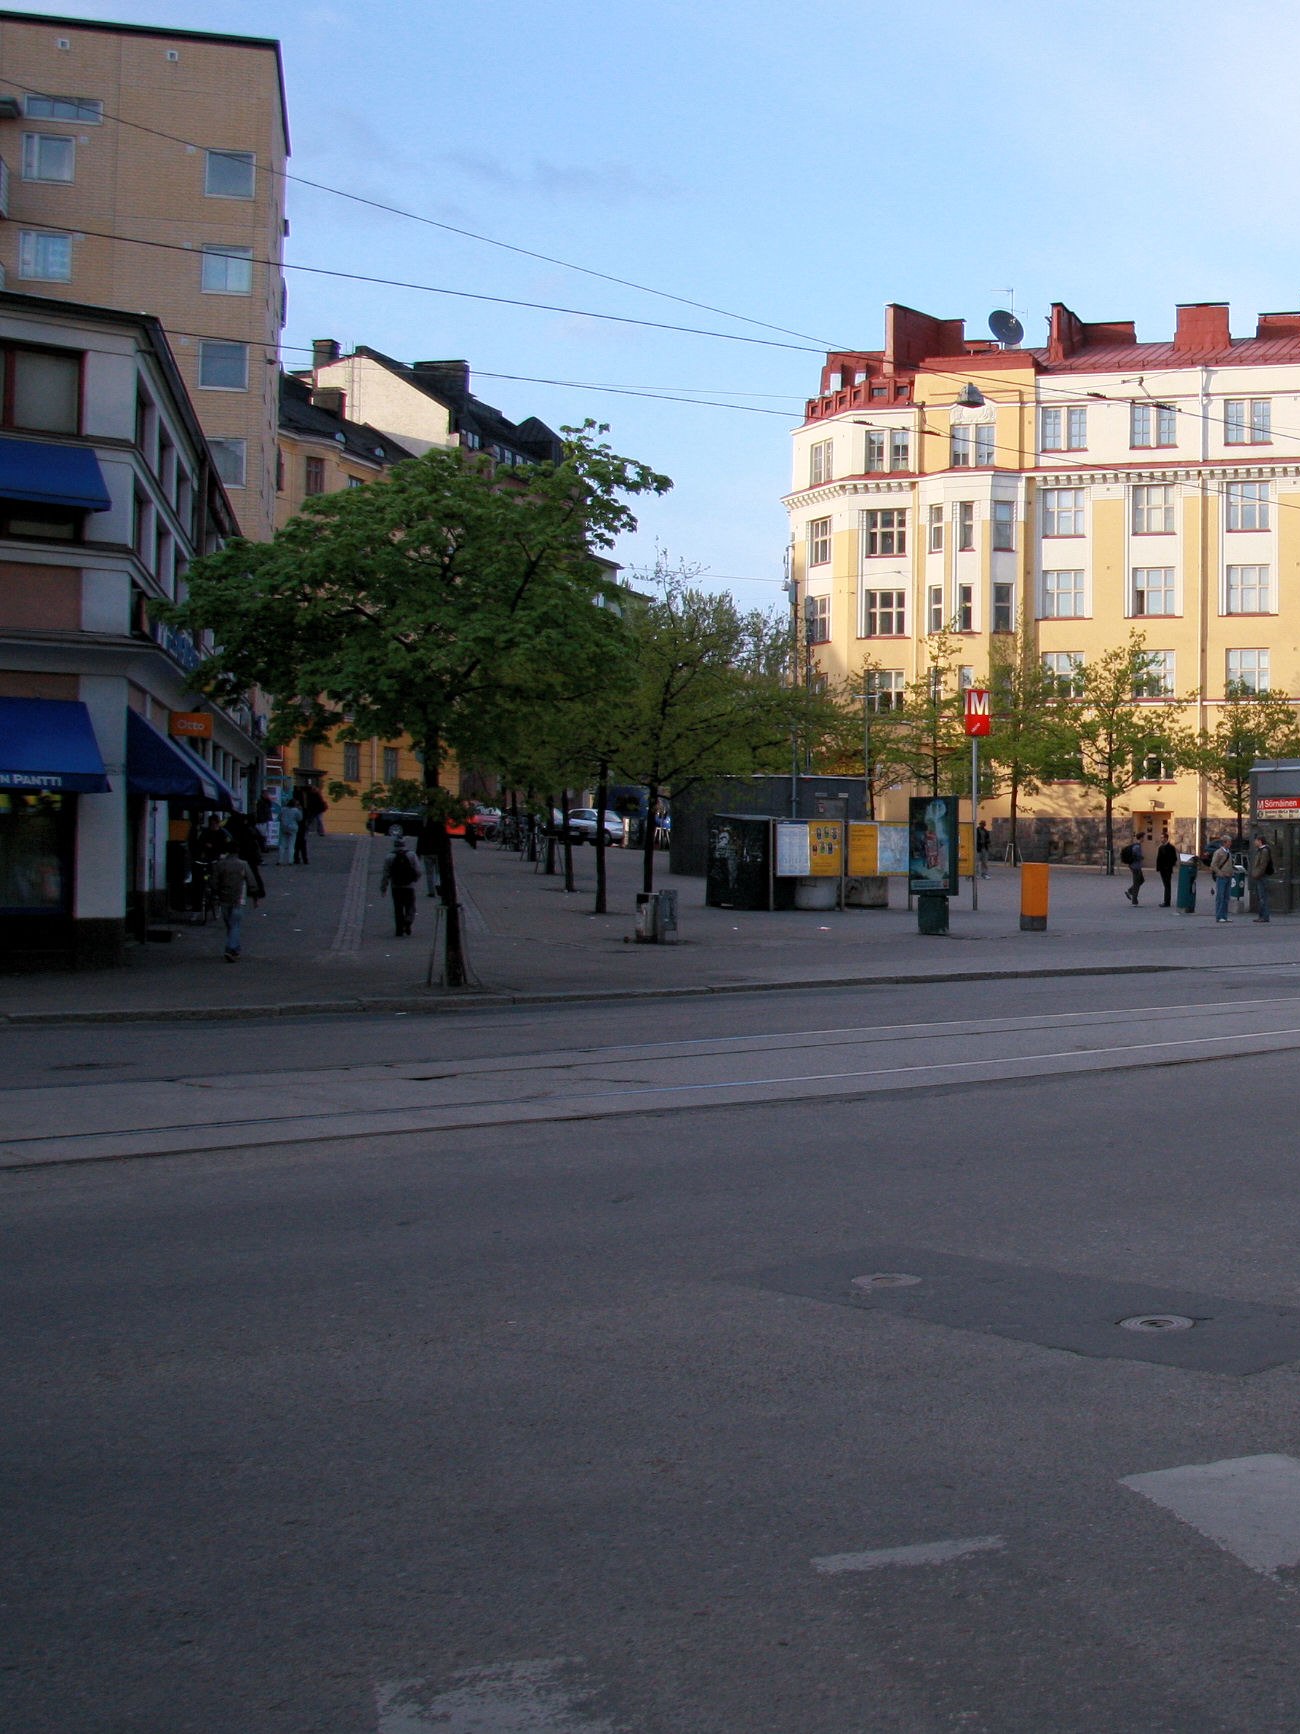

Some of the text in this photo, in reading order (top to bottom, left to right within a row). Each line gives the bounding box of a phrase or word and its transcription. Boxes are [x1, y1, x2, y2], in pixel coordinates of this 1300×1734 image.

[970, 691, 989, 716] M
[177, 719, 205, 730] Otto
[13, 774, 63, 786] PANTTI
[1264, 799, 1298, 808] Sörnäinen
